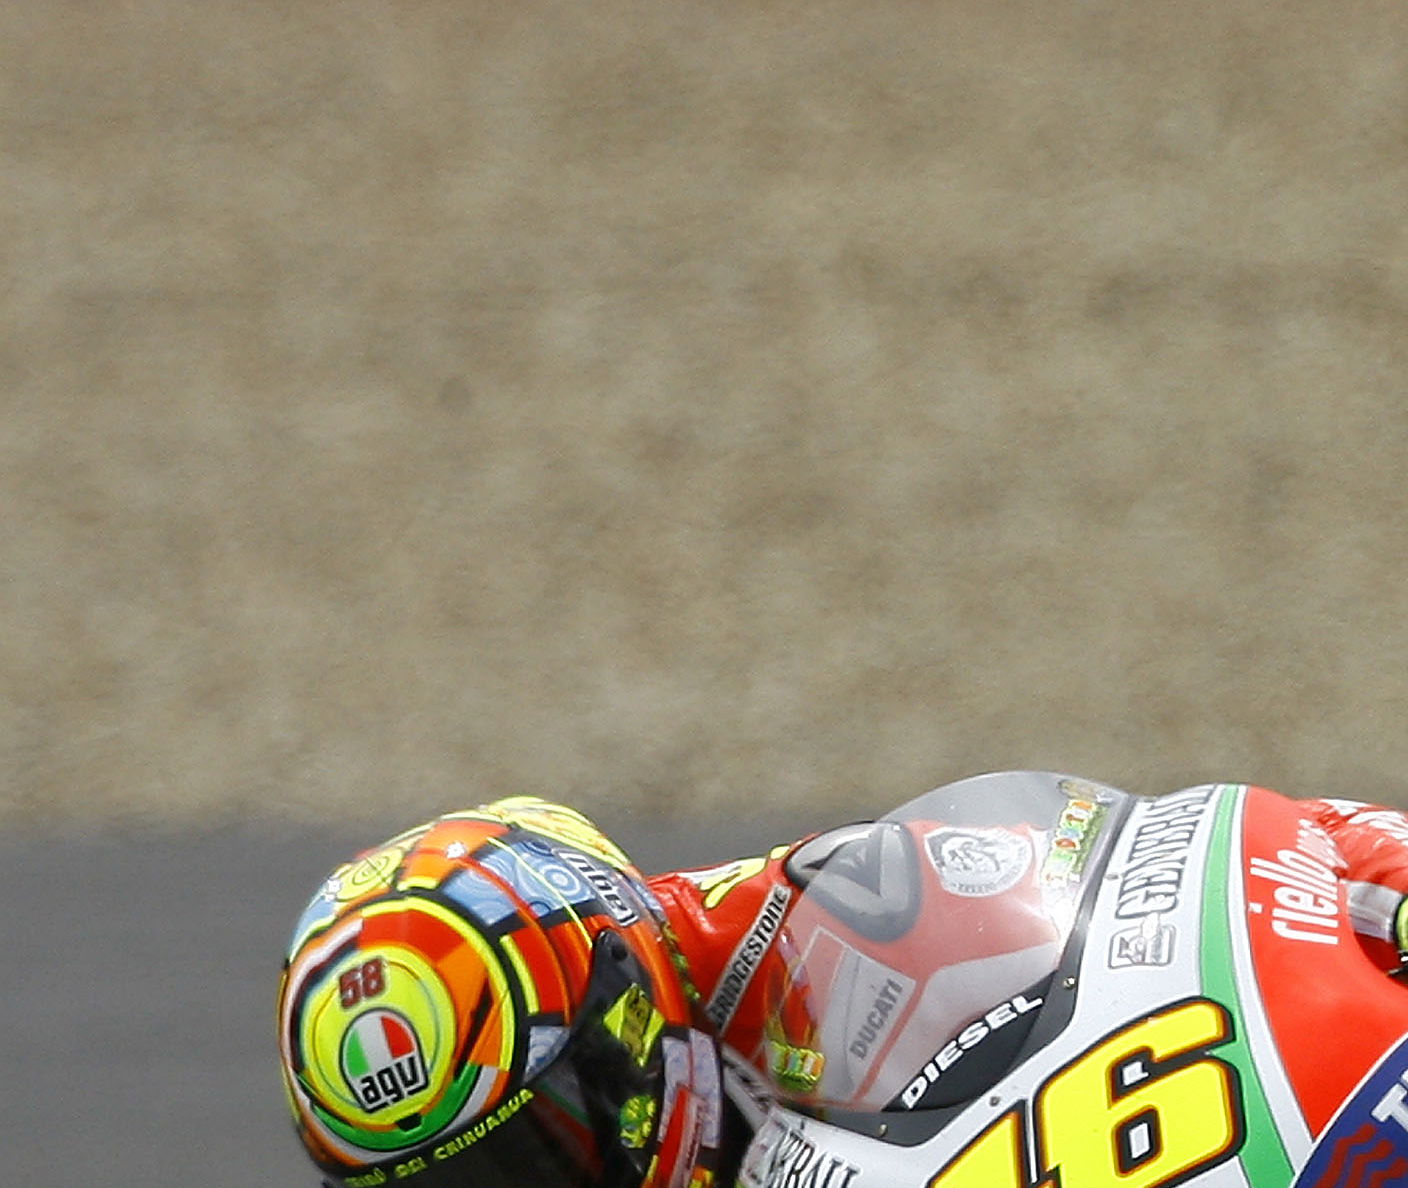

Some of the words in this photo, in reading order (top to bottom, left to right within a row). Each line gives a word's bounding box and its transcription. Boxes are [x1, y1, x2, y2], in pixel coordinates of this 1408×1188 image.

[1250, 849, 1339, 945] riello
[339, 956, 387, 1010] 58
[708, 884, 788, 1031] BRIDGESTONE
[849, 977, 904, 1065] DUCATI
[901, 993, 1045, 1110] DIESEL
